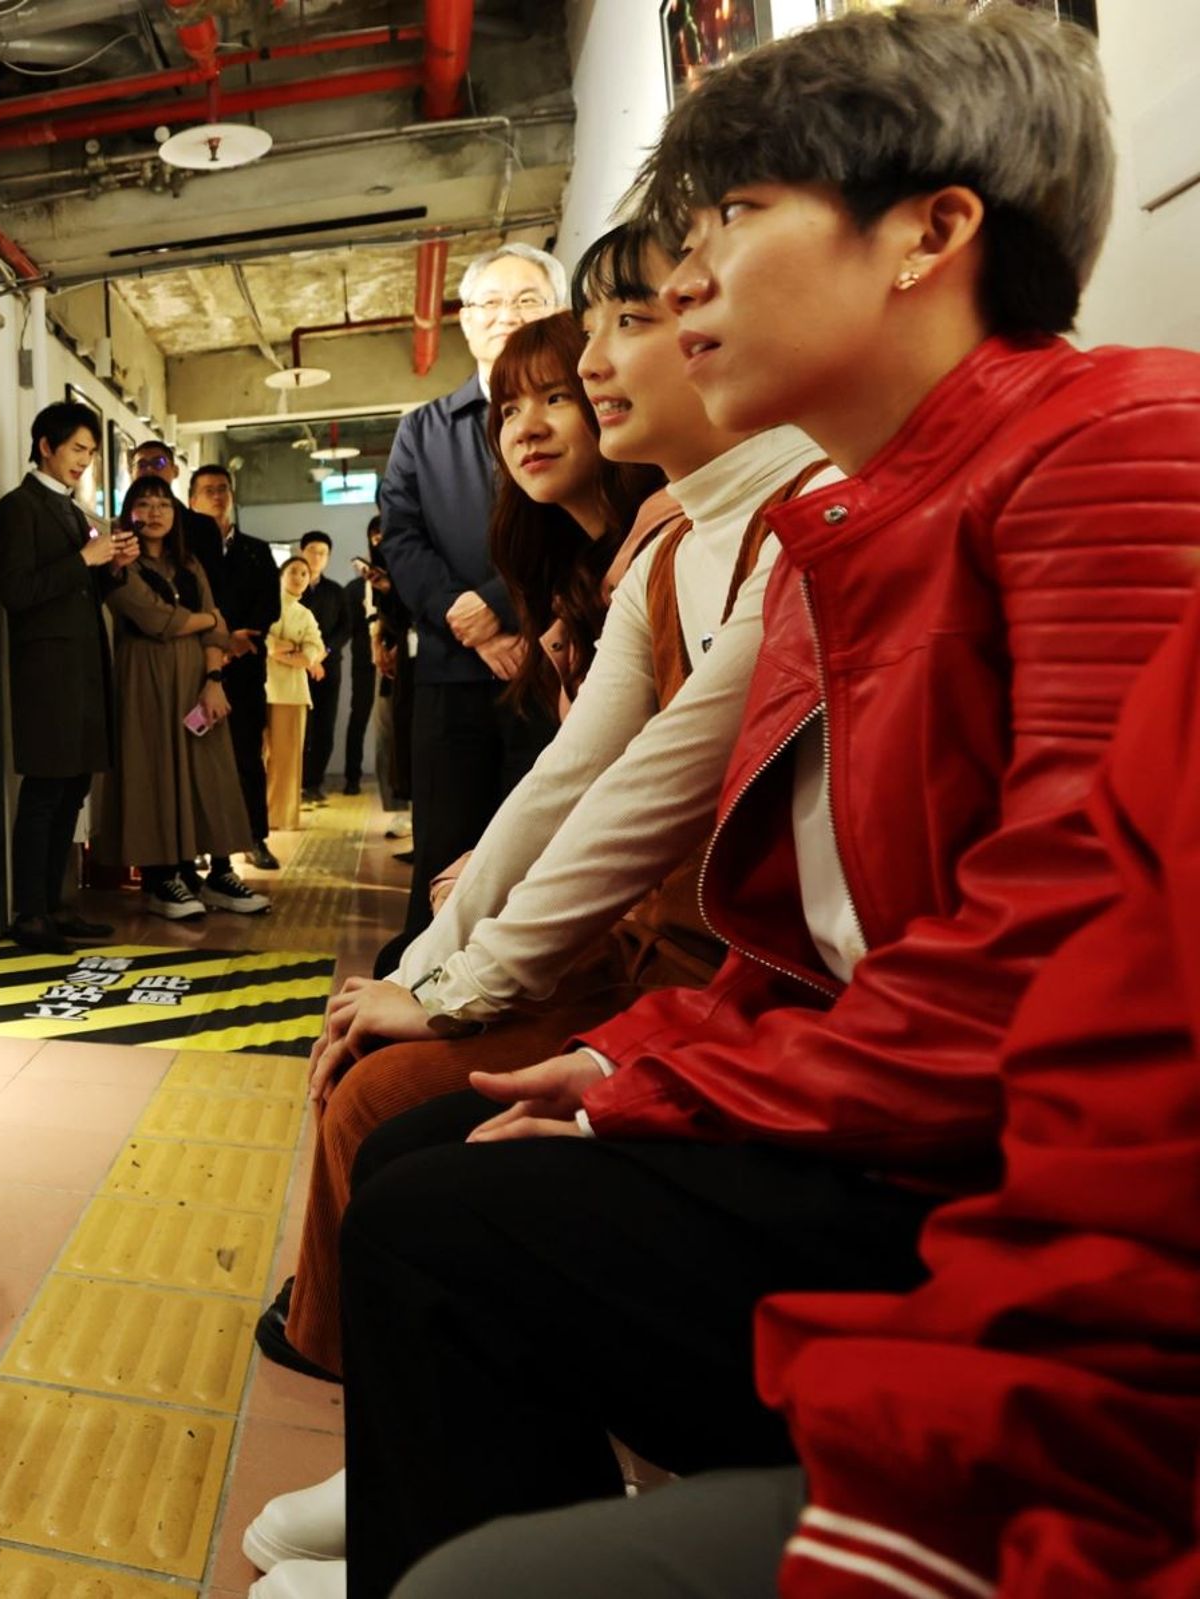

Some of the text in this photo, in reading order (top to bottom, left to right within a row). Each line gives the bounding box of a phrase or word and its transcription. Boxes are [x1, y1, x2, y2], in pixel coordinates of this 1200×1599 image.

[24, 956, 135, 1021] 請勿站立
[127, 975, 193, 1006] 此區
